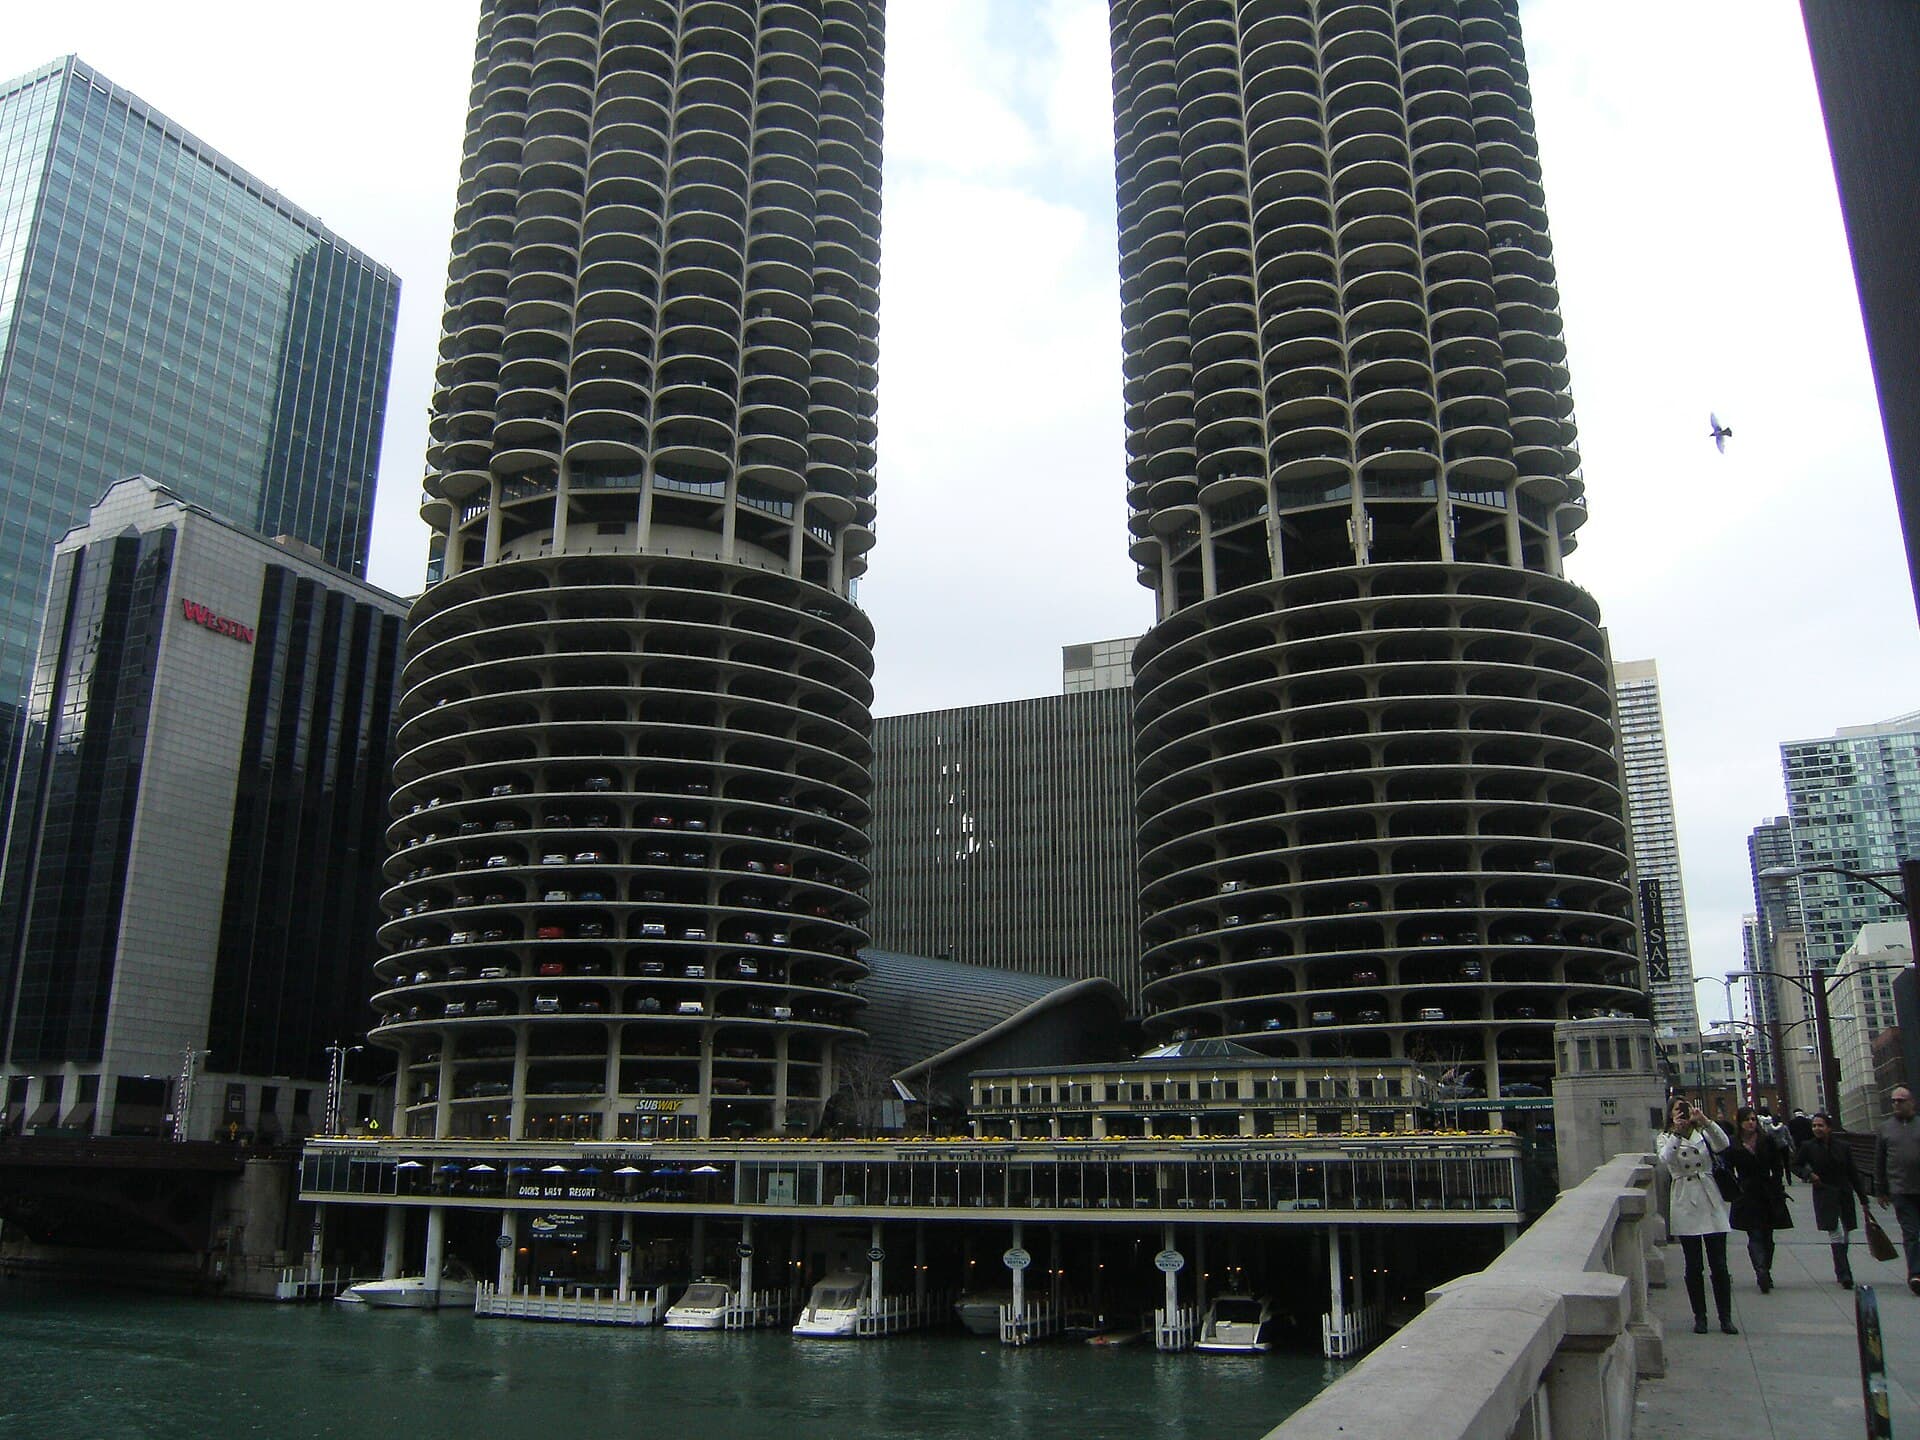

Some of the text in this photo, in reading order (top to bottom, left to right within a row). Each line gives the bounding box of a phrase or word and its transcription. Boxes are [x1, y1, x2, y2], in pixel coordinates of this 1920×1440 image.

[182, 599, 254, 643] WESTIN
[1648, 882, 1666, 977] HOTEL SAX
[636, 1099, 683, 1111] SUBWAY
[896, 1153, 929, 1161] SMITH
[949, 1153, 1012, 1161] WOLLENSKY
[1057, 1153, 1120, 1161] SINCE 1977
[1445, 1150, 1486, 1158] GRILL
[544, 1187, 562, 1196] LAST
[569, 1187, 596, 1197] RESORT
